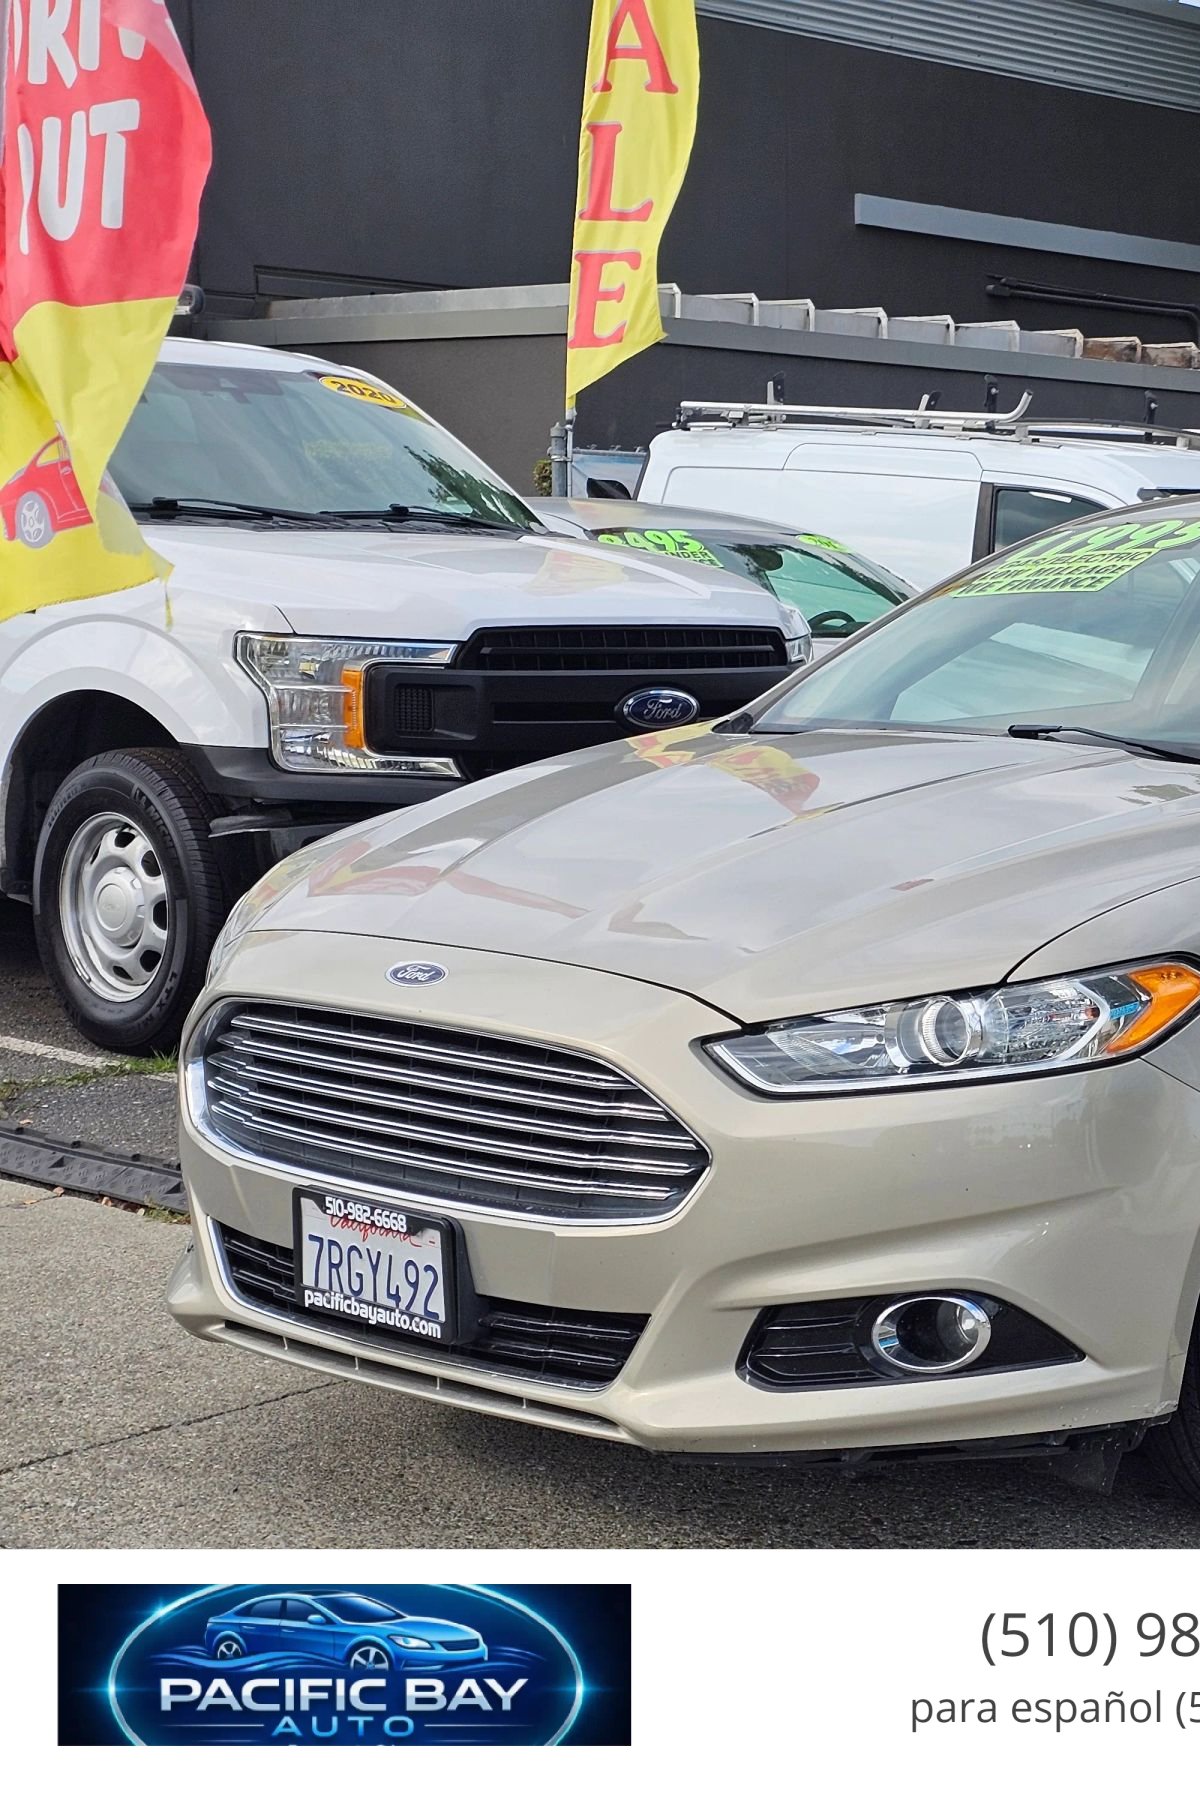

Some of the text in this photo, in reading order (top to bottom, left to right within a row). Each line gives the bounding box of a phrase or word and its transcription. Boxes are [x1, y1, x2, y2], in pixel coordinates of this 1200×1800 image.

[330, 380, 398, 404] 2020
[1025, 564, 1132, 578] MILEAGE
[996, 576, 1113, 592] FINANCE
[643, 698, 683, 720] Ford
[396, 965, 436, 982] Ford
[325, 1196, 407, 1233] 510-982-6668
[308, 1233, 441, 1321] 7RGY492
[304, 1289, 442, 1339] pacificbayauto.com
